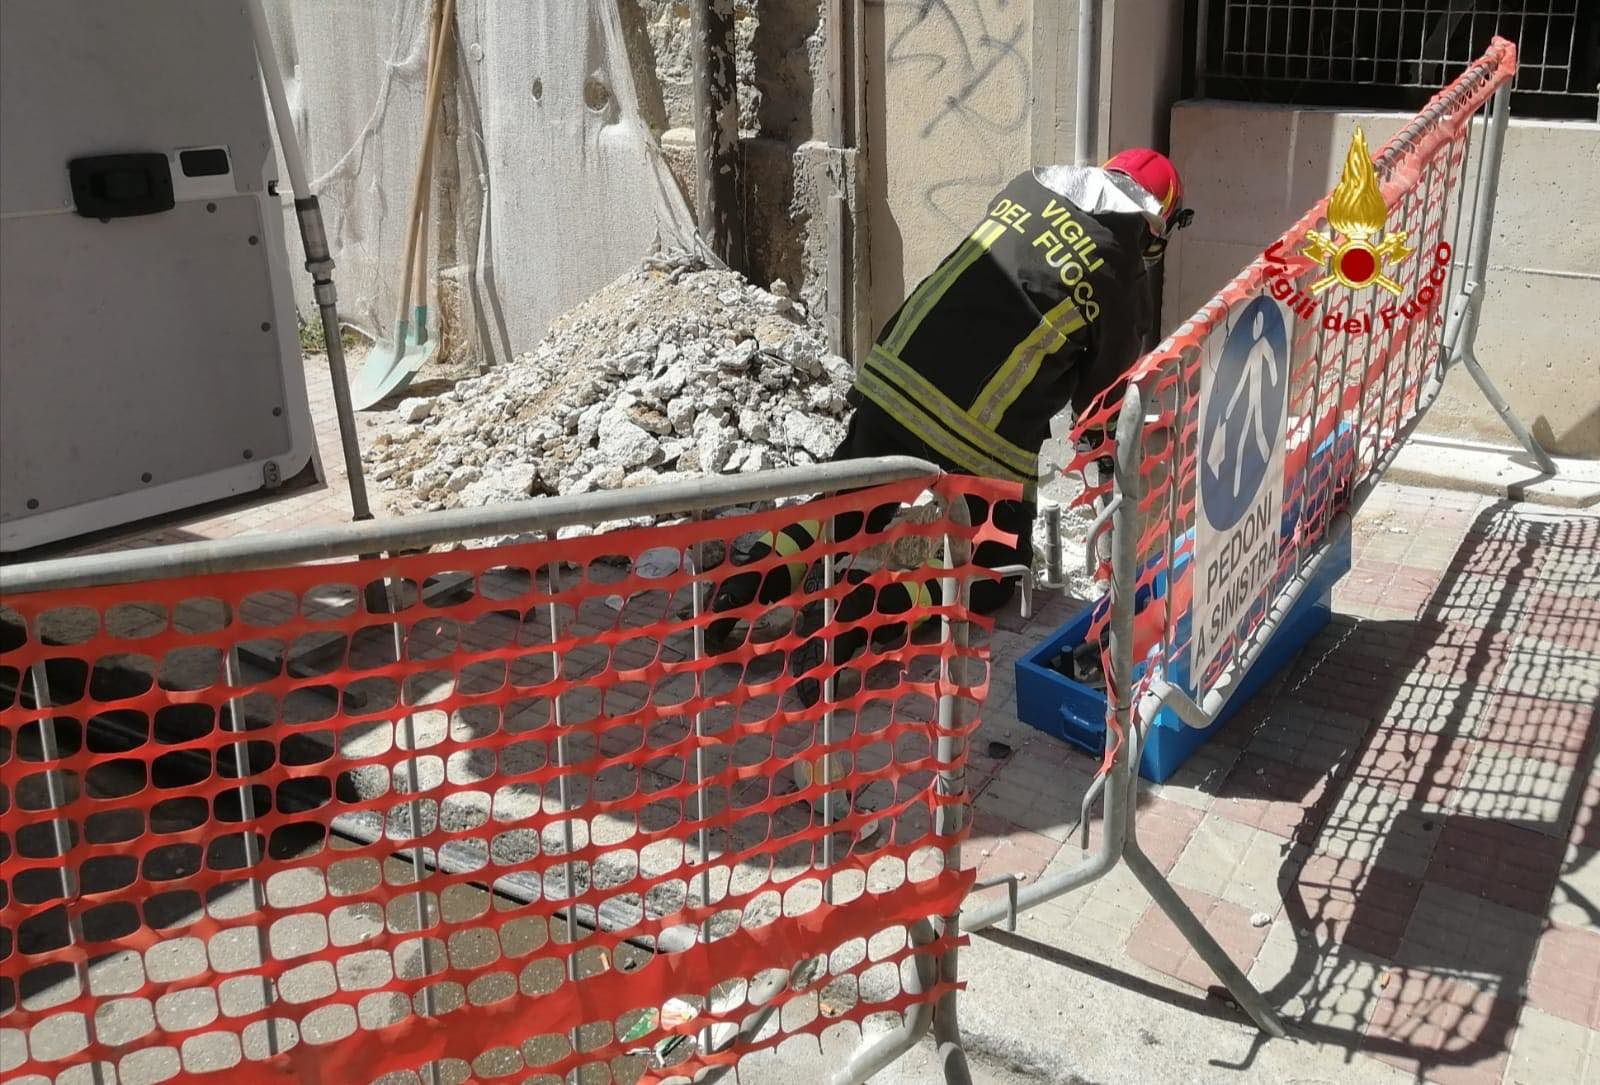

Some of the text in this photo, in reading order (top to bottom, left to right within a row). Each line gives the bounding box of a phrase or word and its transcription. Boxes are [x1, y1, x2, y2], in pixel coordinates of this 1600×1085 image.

[990, 199, 1100, 323] DEL FUOCO
[1041, 199, 1105, 273] VIGILI
[1195, 530, 1278, 669] A SINISTRA
[1207, 490, 1273, 604] PEDONI
